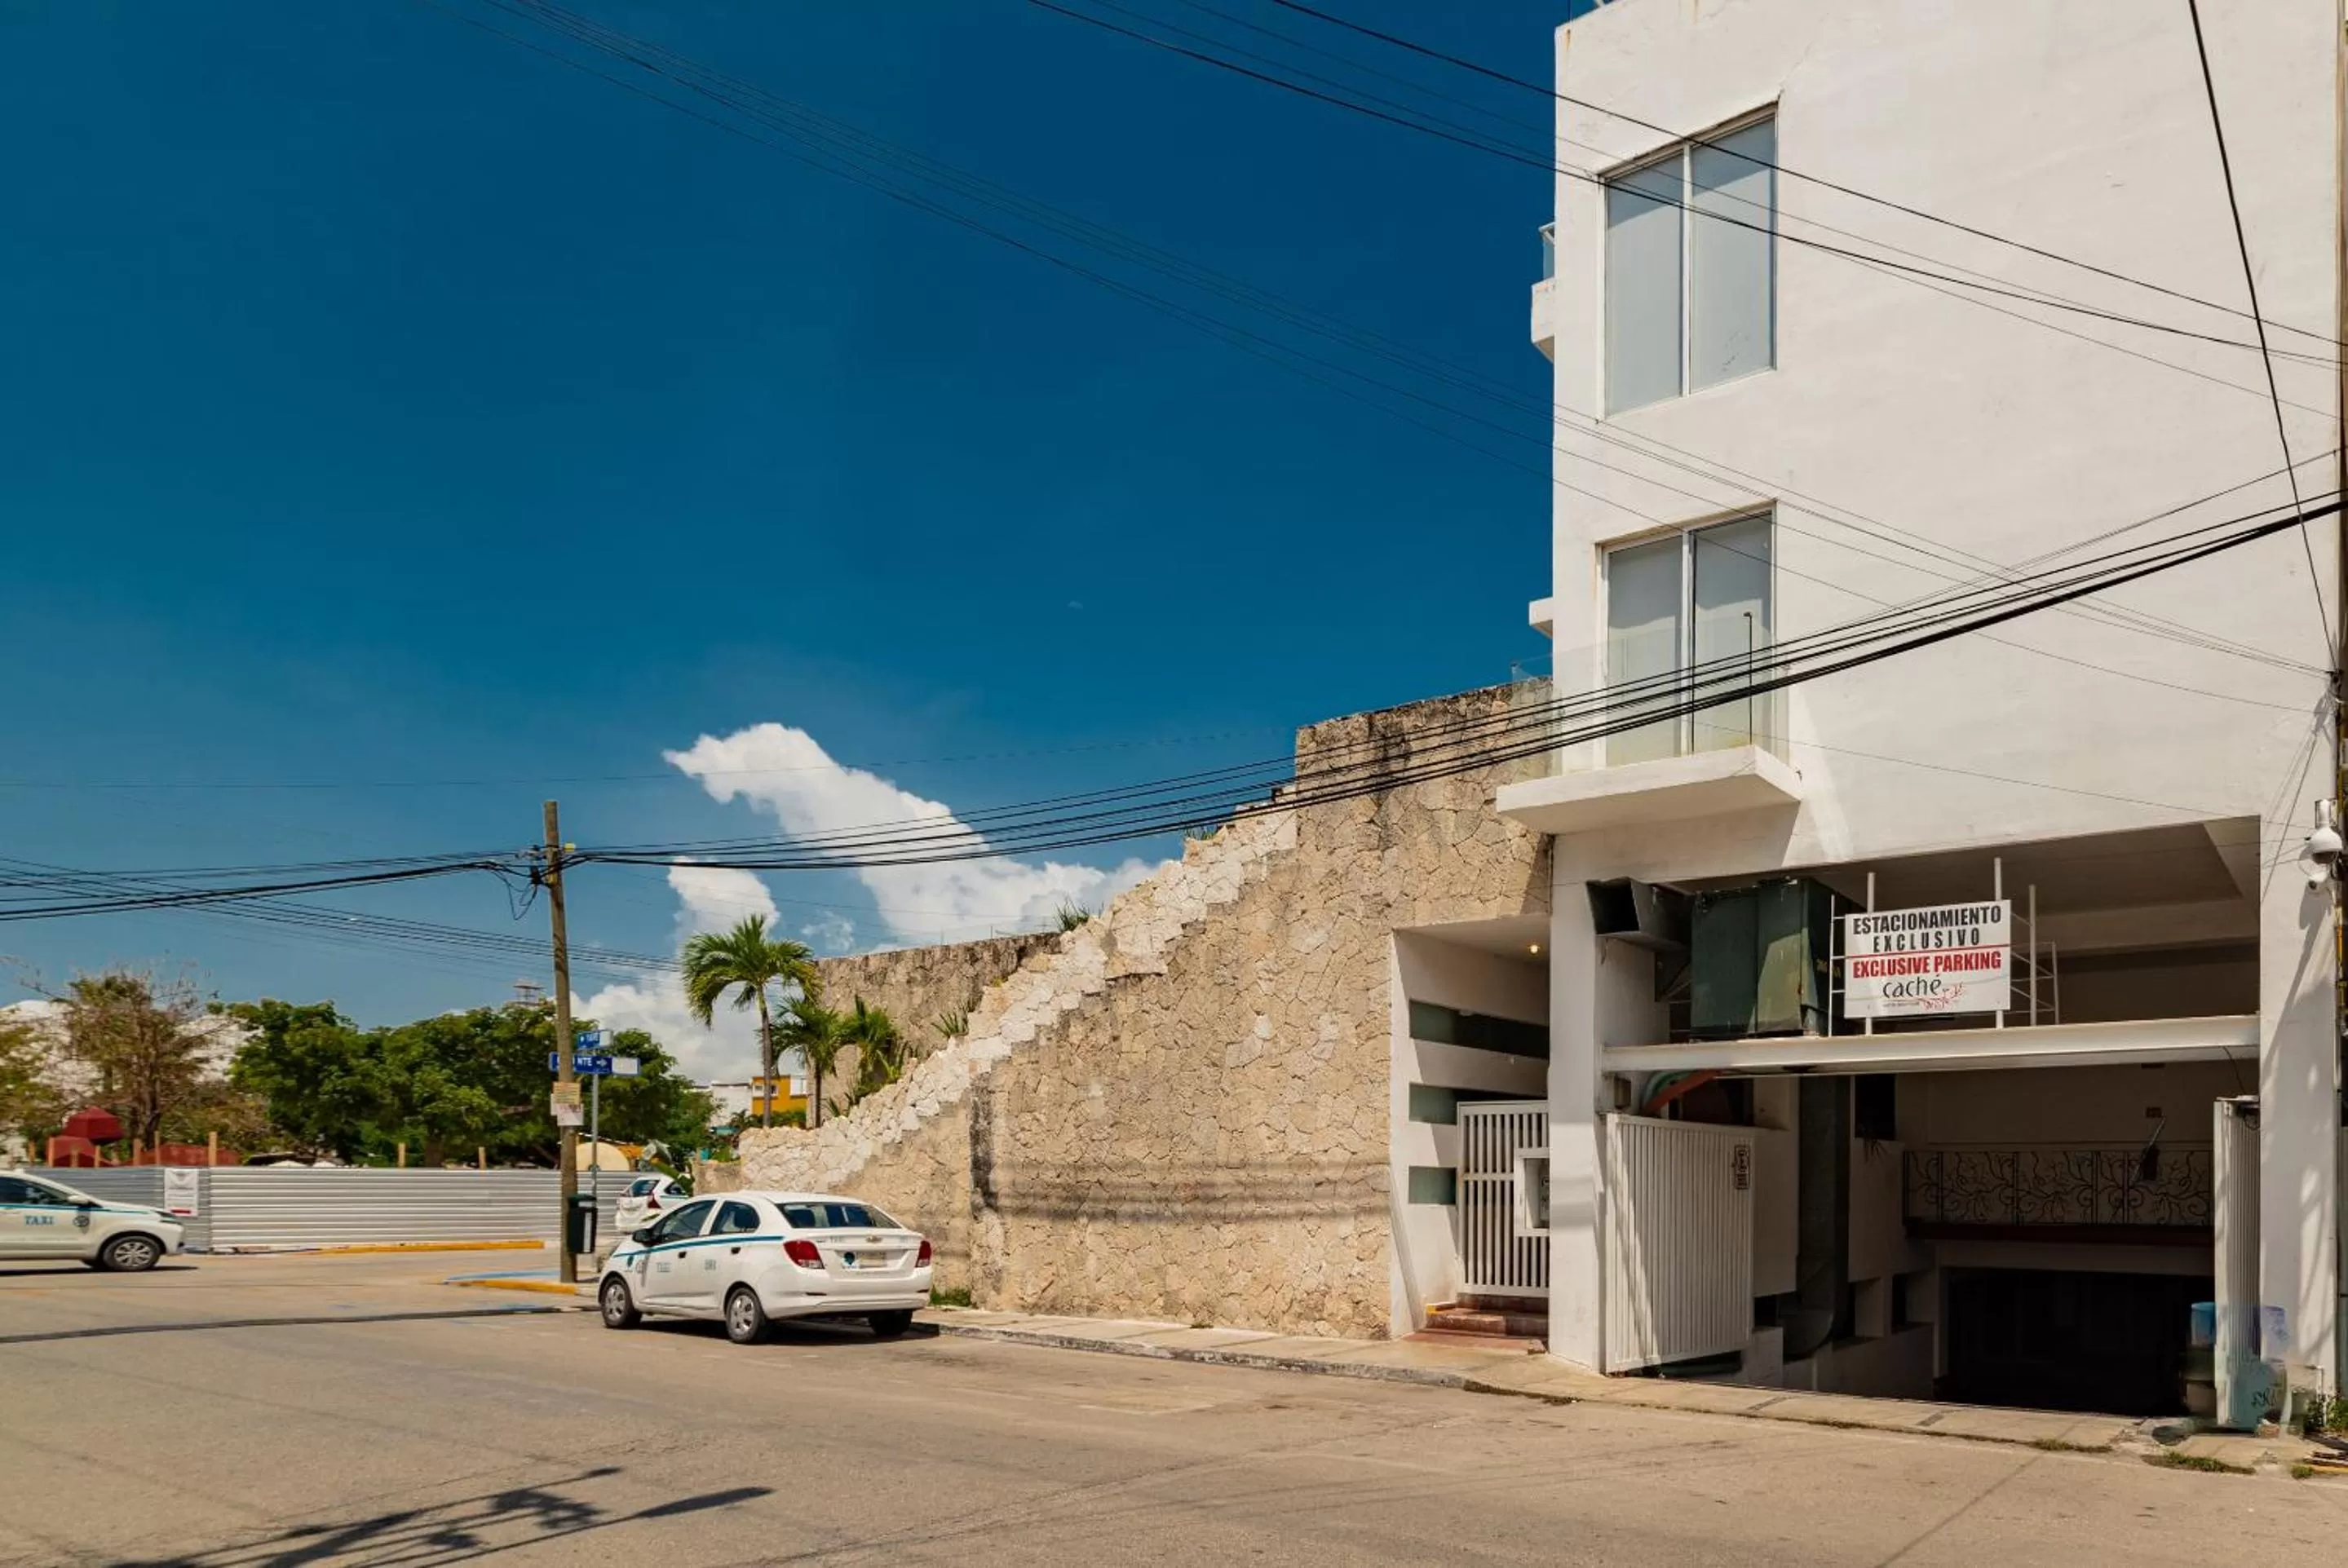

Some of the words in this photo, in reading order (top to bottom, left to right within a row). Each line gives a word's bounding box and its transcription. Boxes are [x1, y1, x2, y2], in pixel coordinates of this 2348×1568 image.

[1853, 905, 2001, 934] ESTACIONAMIENTO
[1873, 928, 1980, 952] EXCLUSIVO
[1853, 956, 1930, 978] EXCLUSIVE
[1935, 951, 2001, 972] PARKING
